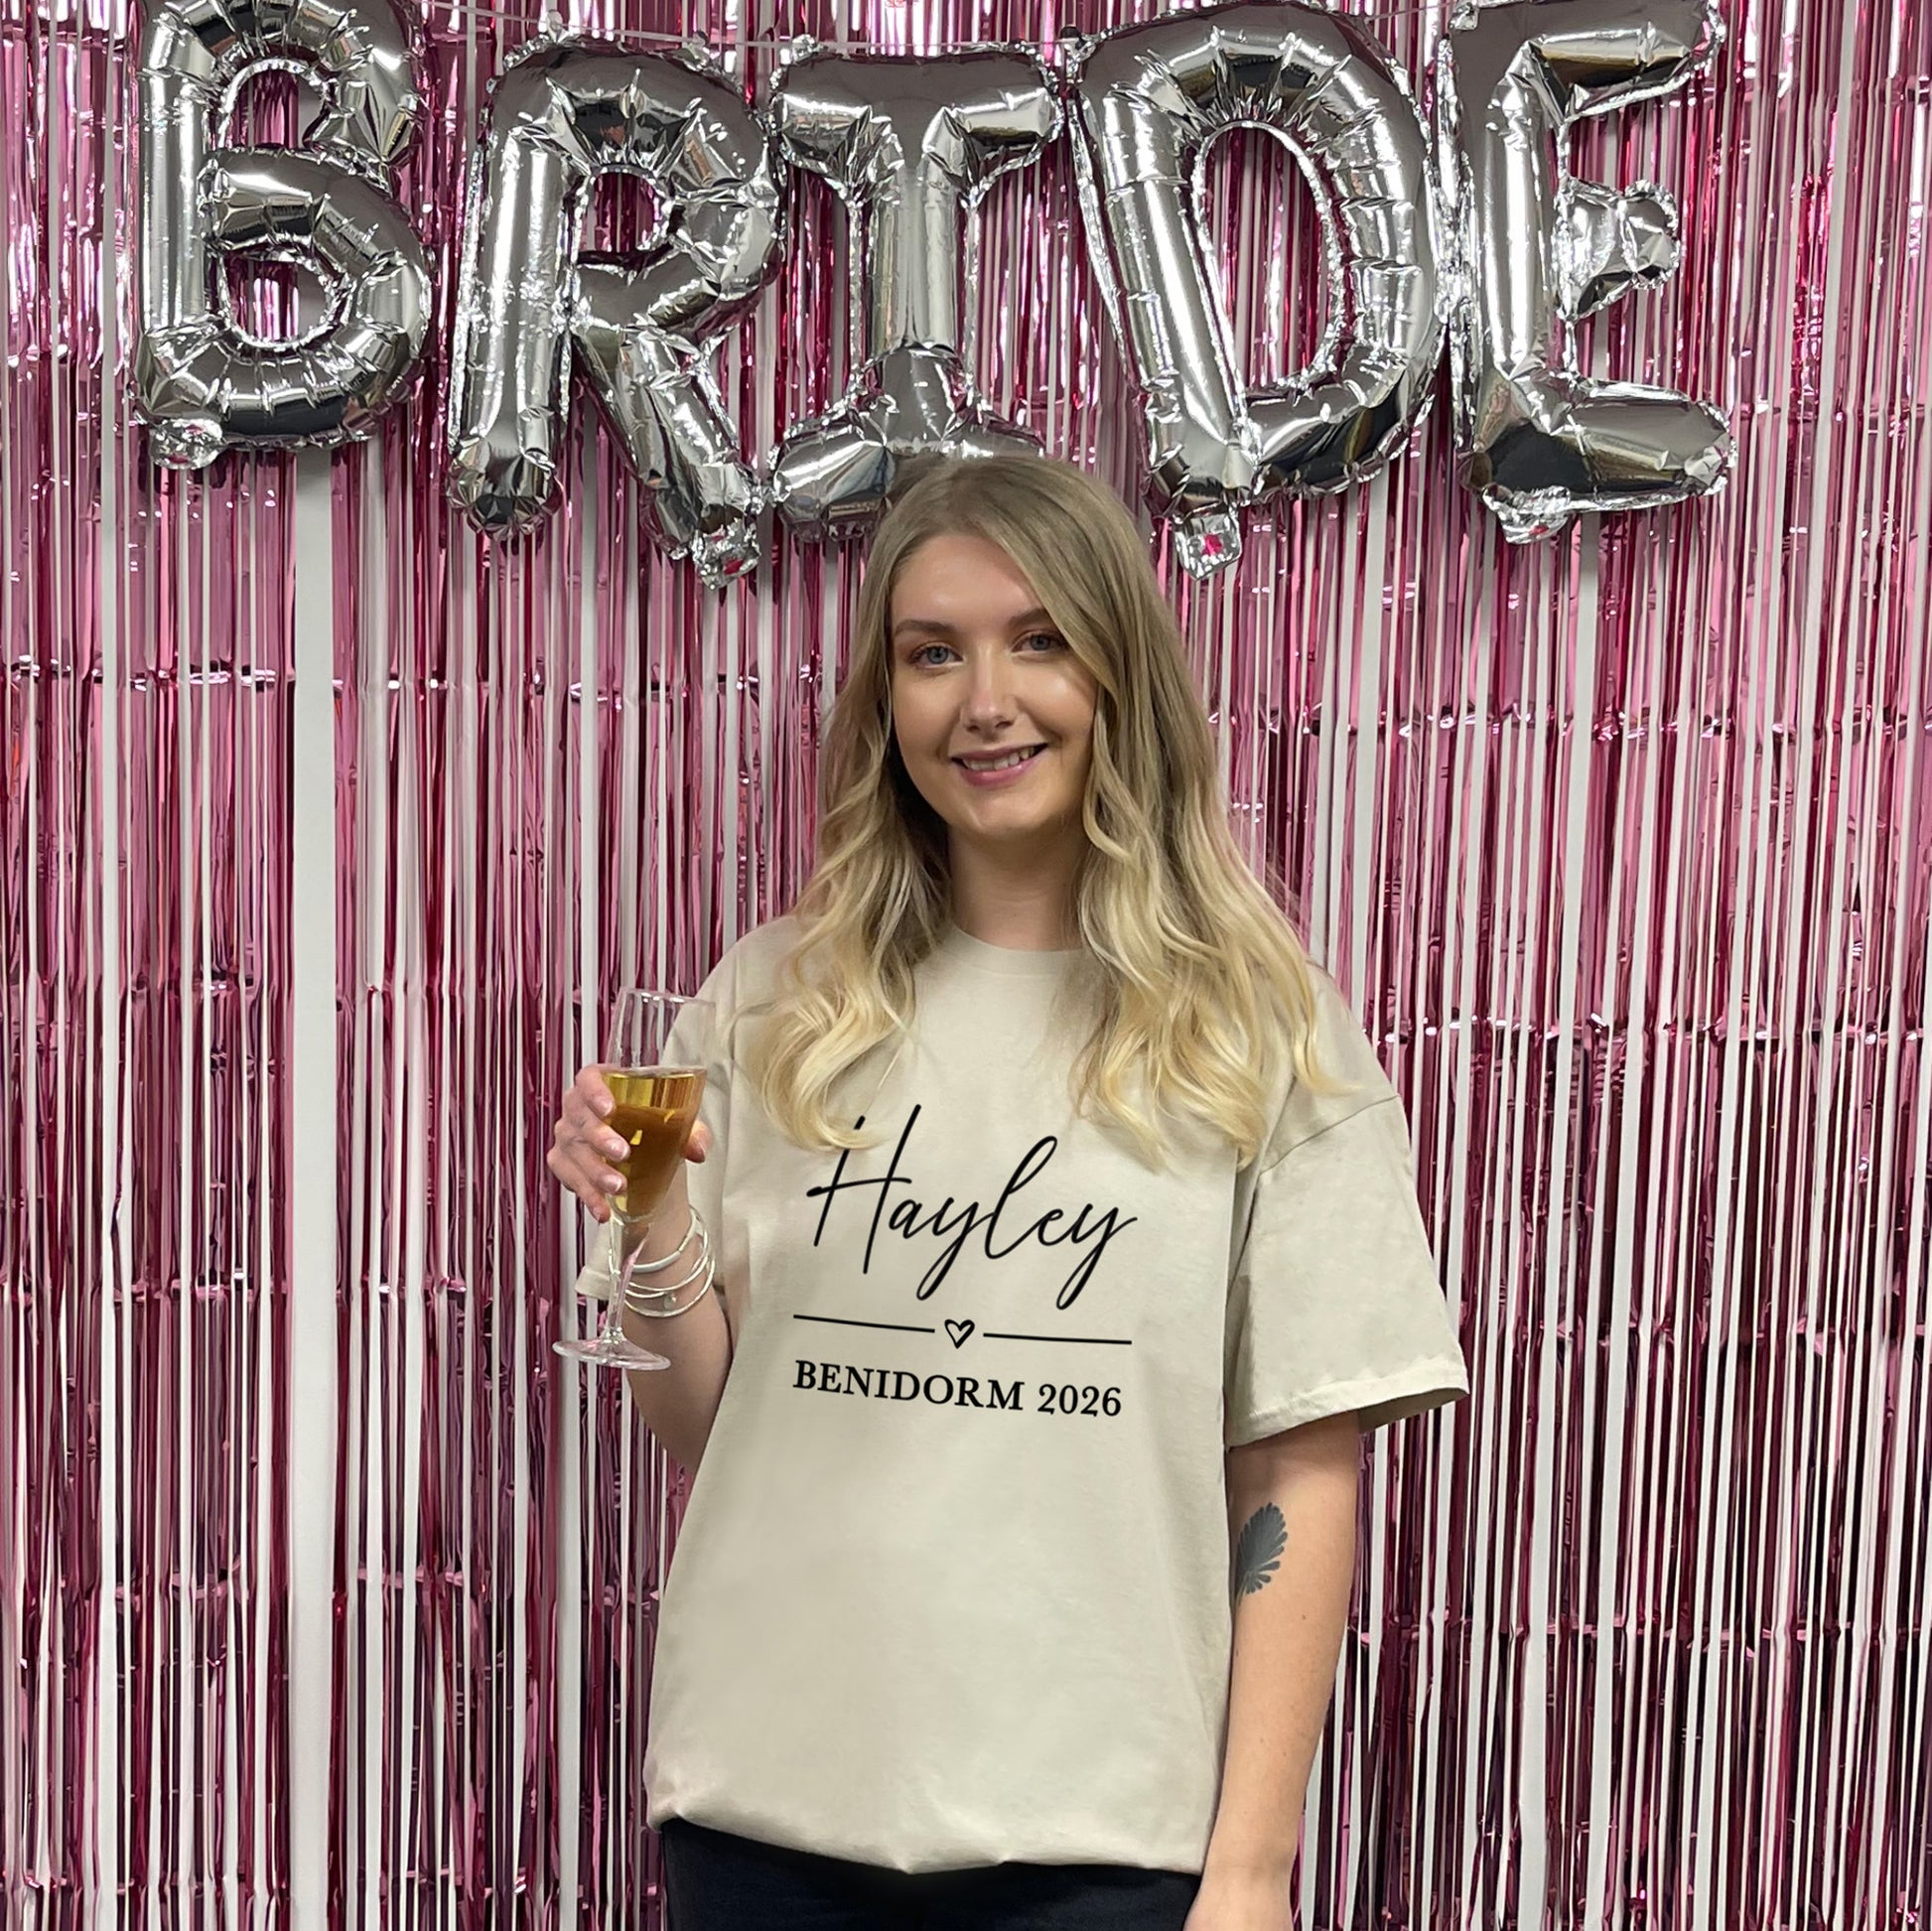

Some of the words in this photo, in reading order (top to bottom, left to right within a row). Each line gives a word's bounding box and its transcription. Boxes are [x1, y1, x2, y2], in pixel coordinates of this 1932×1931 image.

[131, 0, 1737, 584] BRIDE
[806, 1104, 1138, 1310] Hayley
[792, 1359, 1025, 1411] BENIDORM
[1037, 1383, 1122, 1417] 2026
